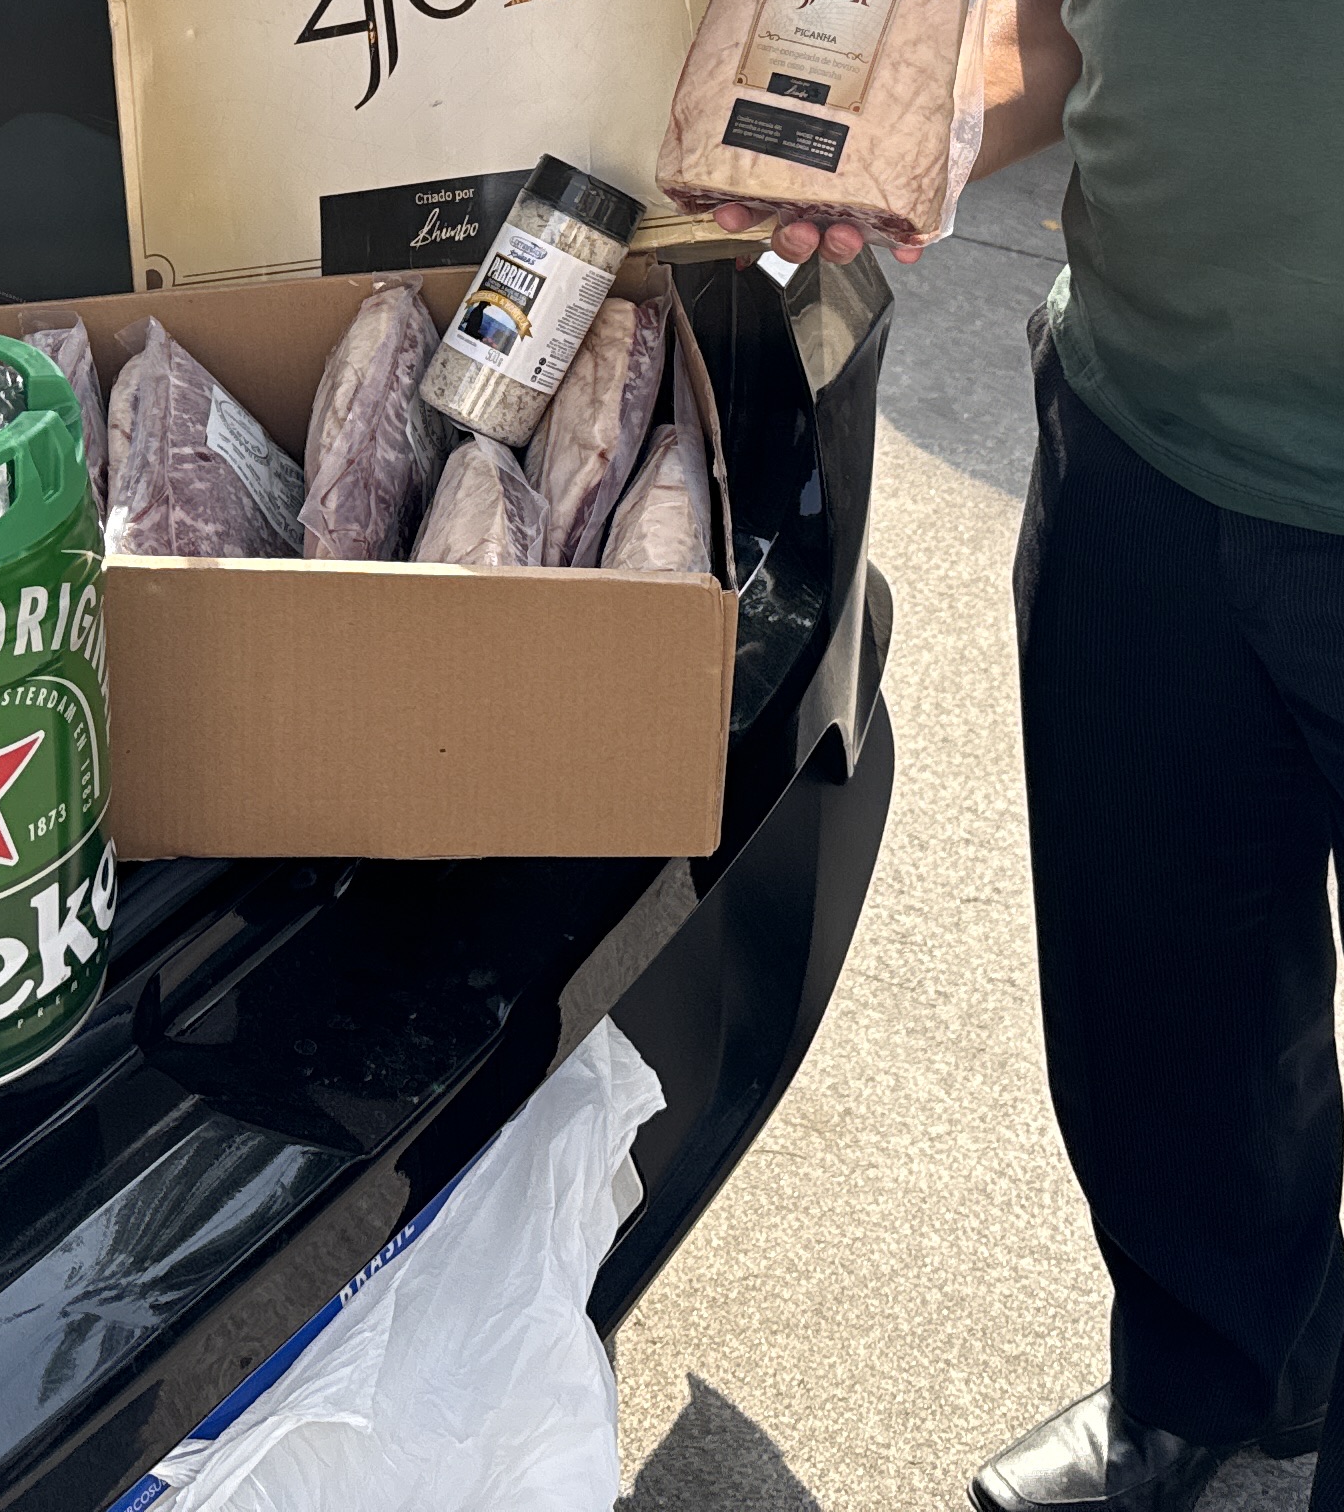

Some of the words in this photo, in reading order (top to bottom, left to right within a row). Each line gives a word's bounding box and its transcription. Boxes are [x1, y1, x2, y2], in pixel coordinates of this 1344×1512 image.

[794, 26, 837, 45] PICANHA
[416, 189, 453, 205] Criado
[455, 188, 475, 203] por
[487, 256, 540, 300] PARRILLA
[73, 722, 89, 753] EN
[80, 757, 93, 813] 1883
[27, 802, 67, 842] 1873
